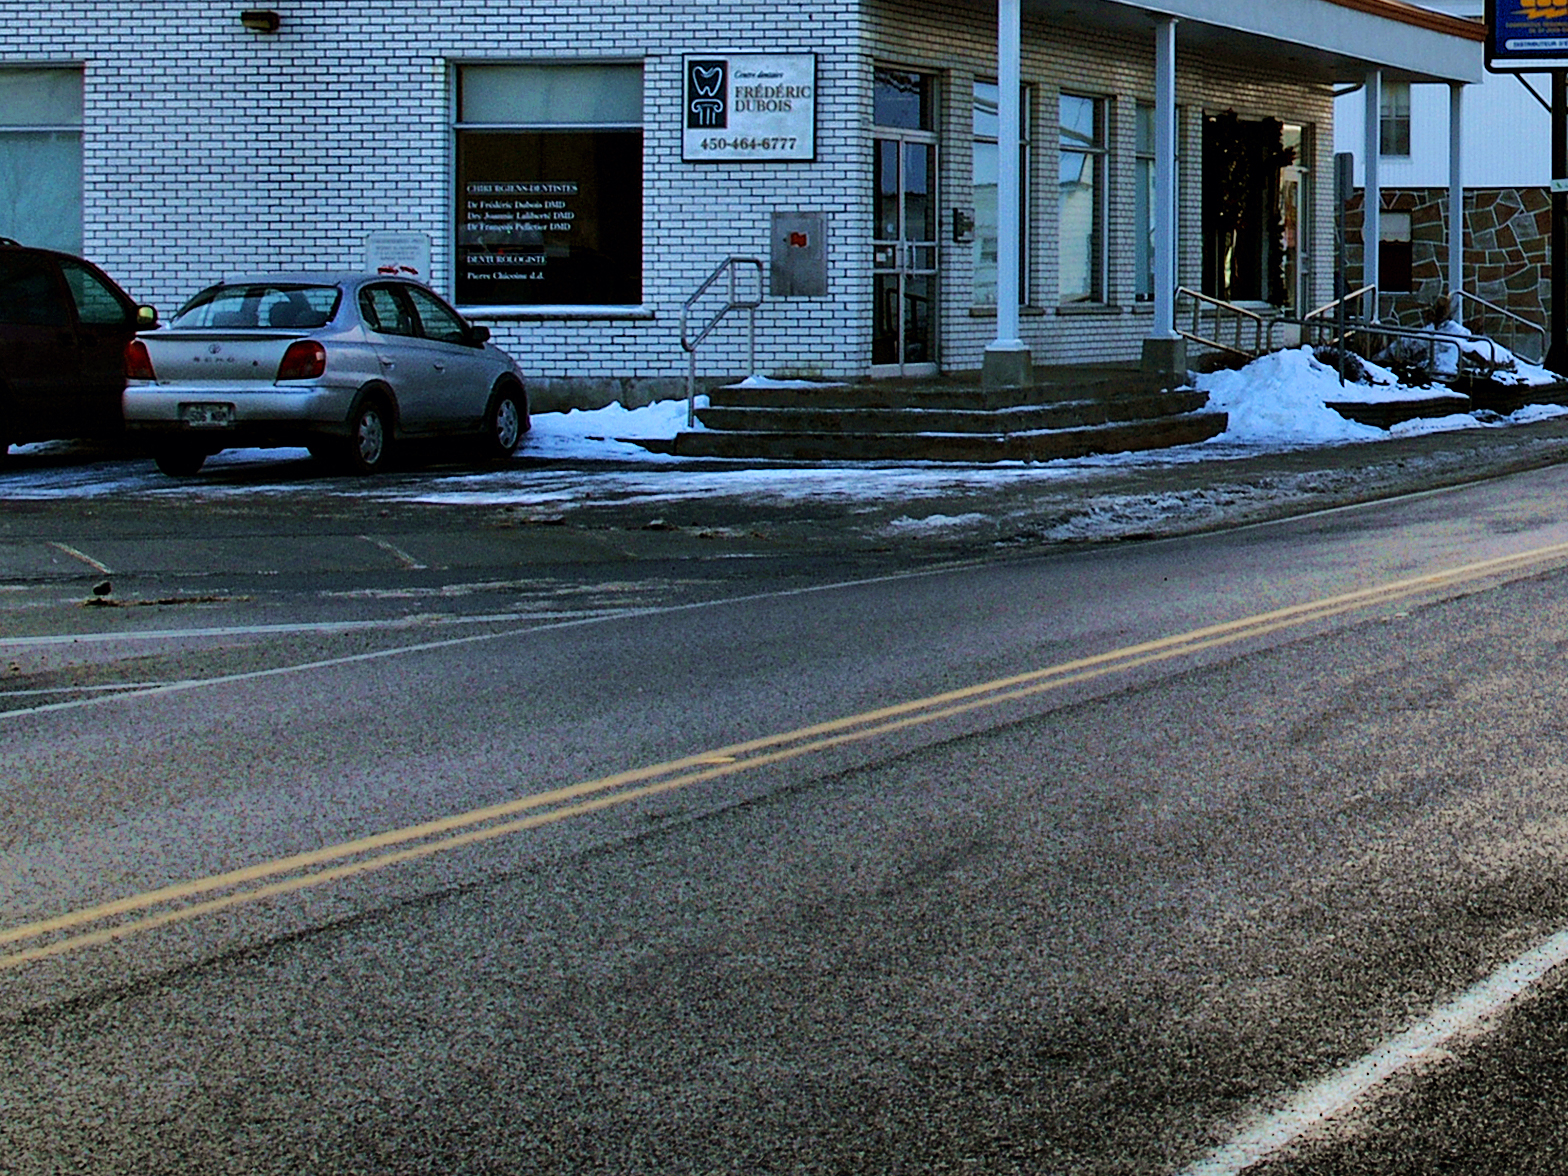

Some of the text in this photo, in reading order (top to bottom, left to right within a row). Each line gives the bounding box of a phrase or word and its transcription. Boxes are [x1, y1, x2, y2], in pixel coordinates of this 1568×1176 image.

[734, 84, 811, 98] FRÉDÉRIC
[735, 100, 792, 112] DUBOIS
[701, 138, 797, 150] 450-464-6777
[544, 201, 566, 209] DMD
[553, 212, 575, 220] DMD
[550, 223, 571, 231] DMD
